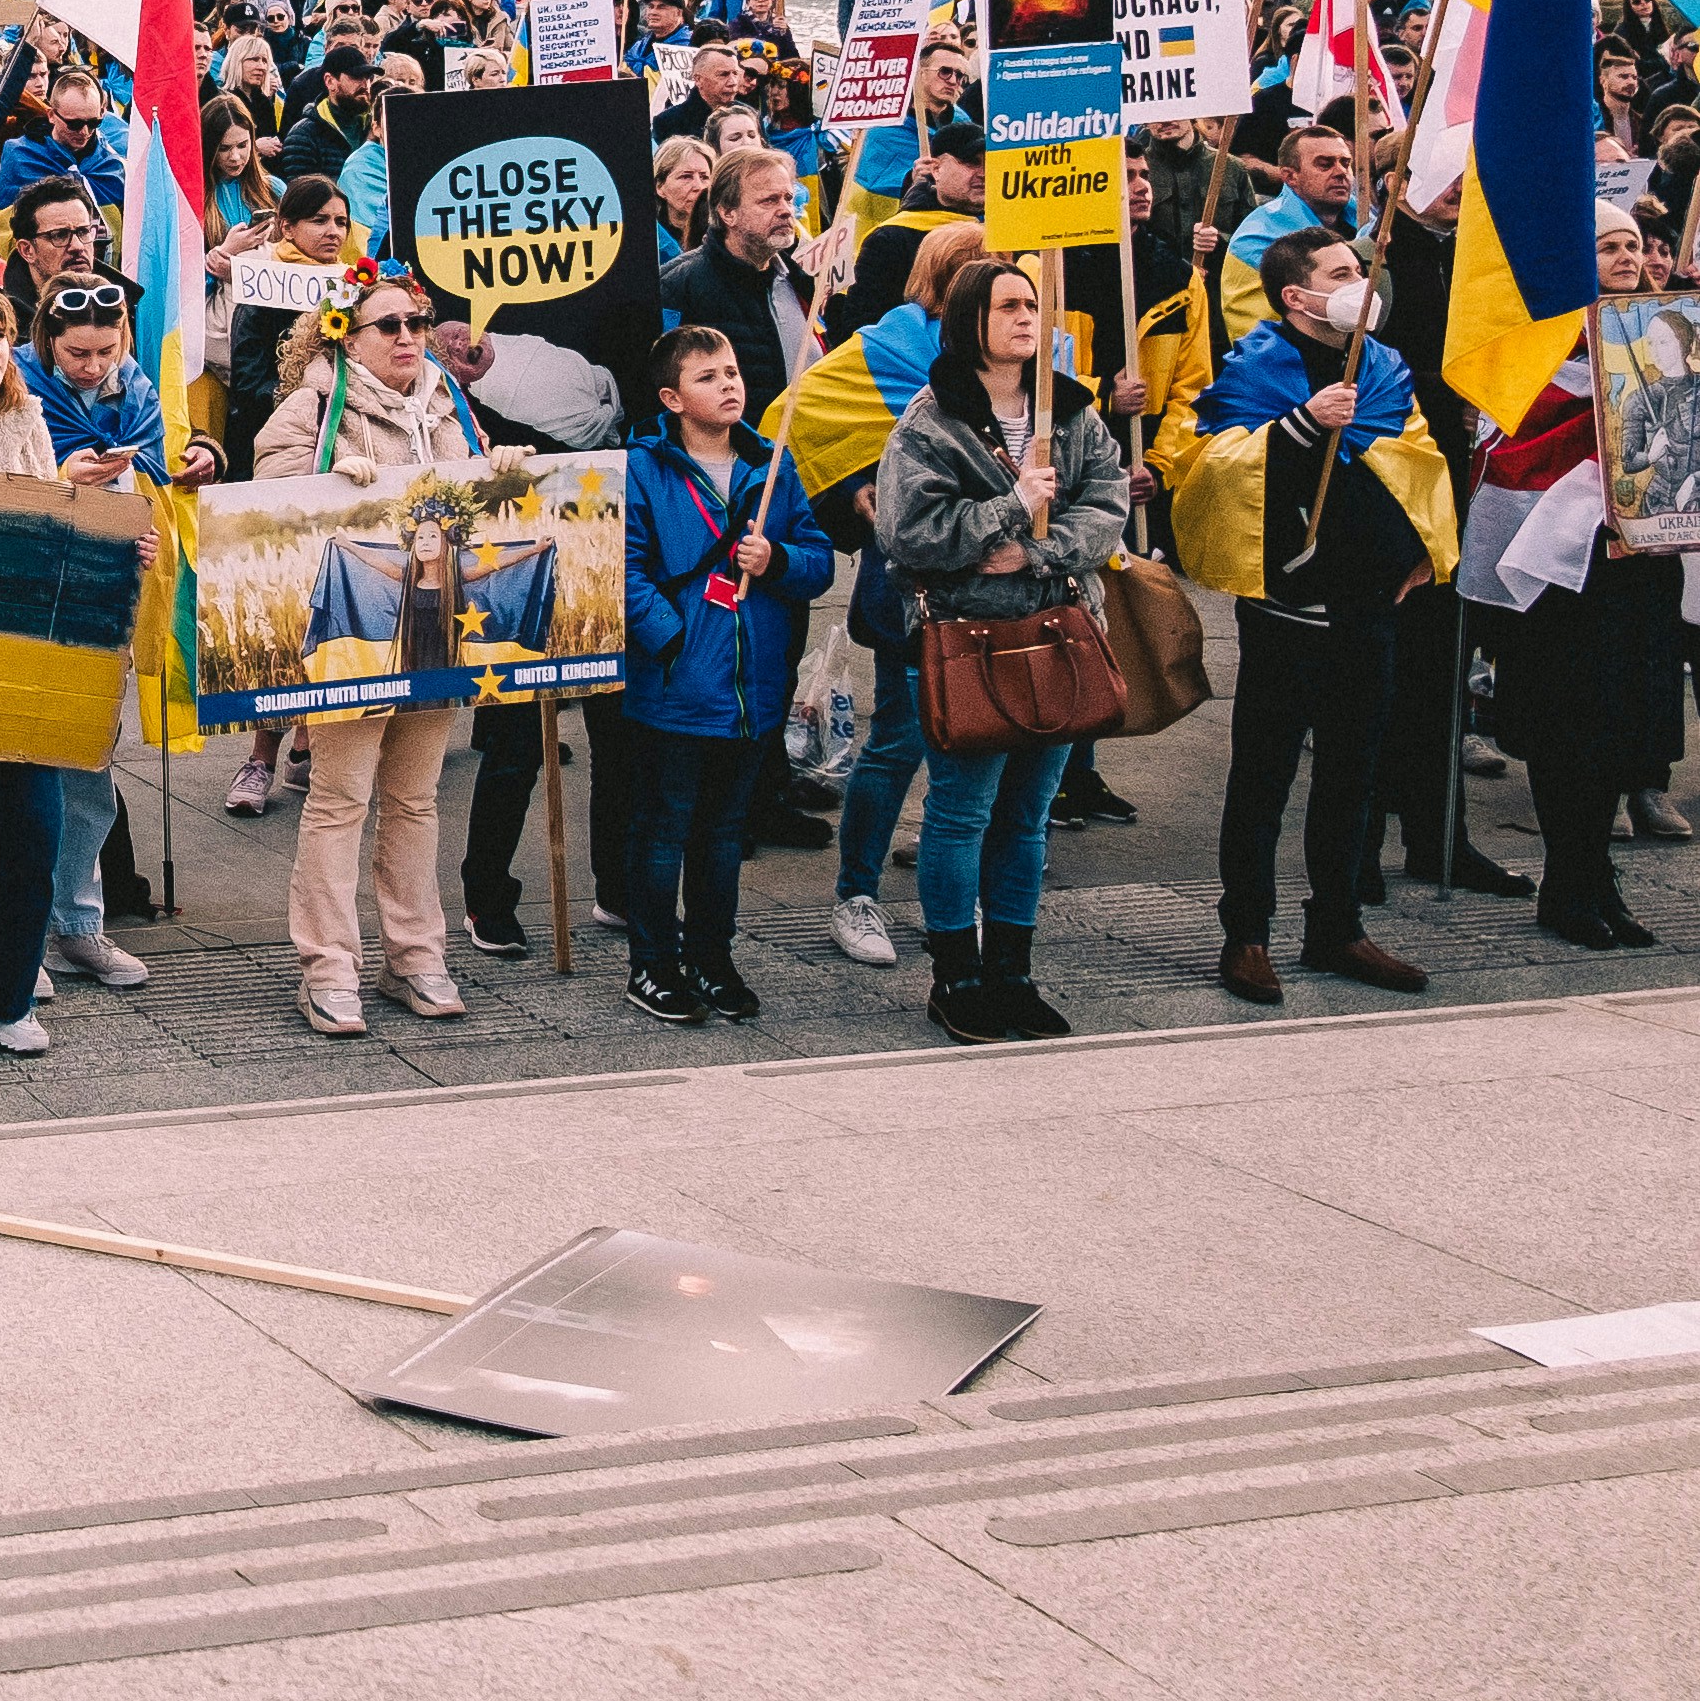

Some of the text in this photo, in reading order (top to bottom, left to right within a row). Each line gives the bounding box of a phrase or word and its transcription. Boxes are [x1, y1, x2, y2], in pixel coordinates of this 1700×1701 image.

[849, 41, 873, 61] UK,
[1117, 29, 1151, 62] ND
[843, 57, 906, 79] DELIVER
[1122, 66, 1197, 104] RAINE
[837, 77, 906, 97] ON YOUR
[832, 95, 903, 119] PROMISE
[991, 107, 1119, 143] Solidarity
[1024, 143, 1071, 167] with
[449, 157, 579, 201] CLOSE
[1001, 166, 1109, 200] Ukraine
[431, 195, 619, 242] THE SKY,
[463, 240, 595, 290] NOW!
[254, 660, 618, 713] SOLIDARITY WITH UKRAINE UNITED KINGDOM
